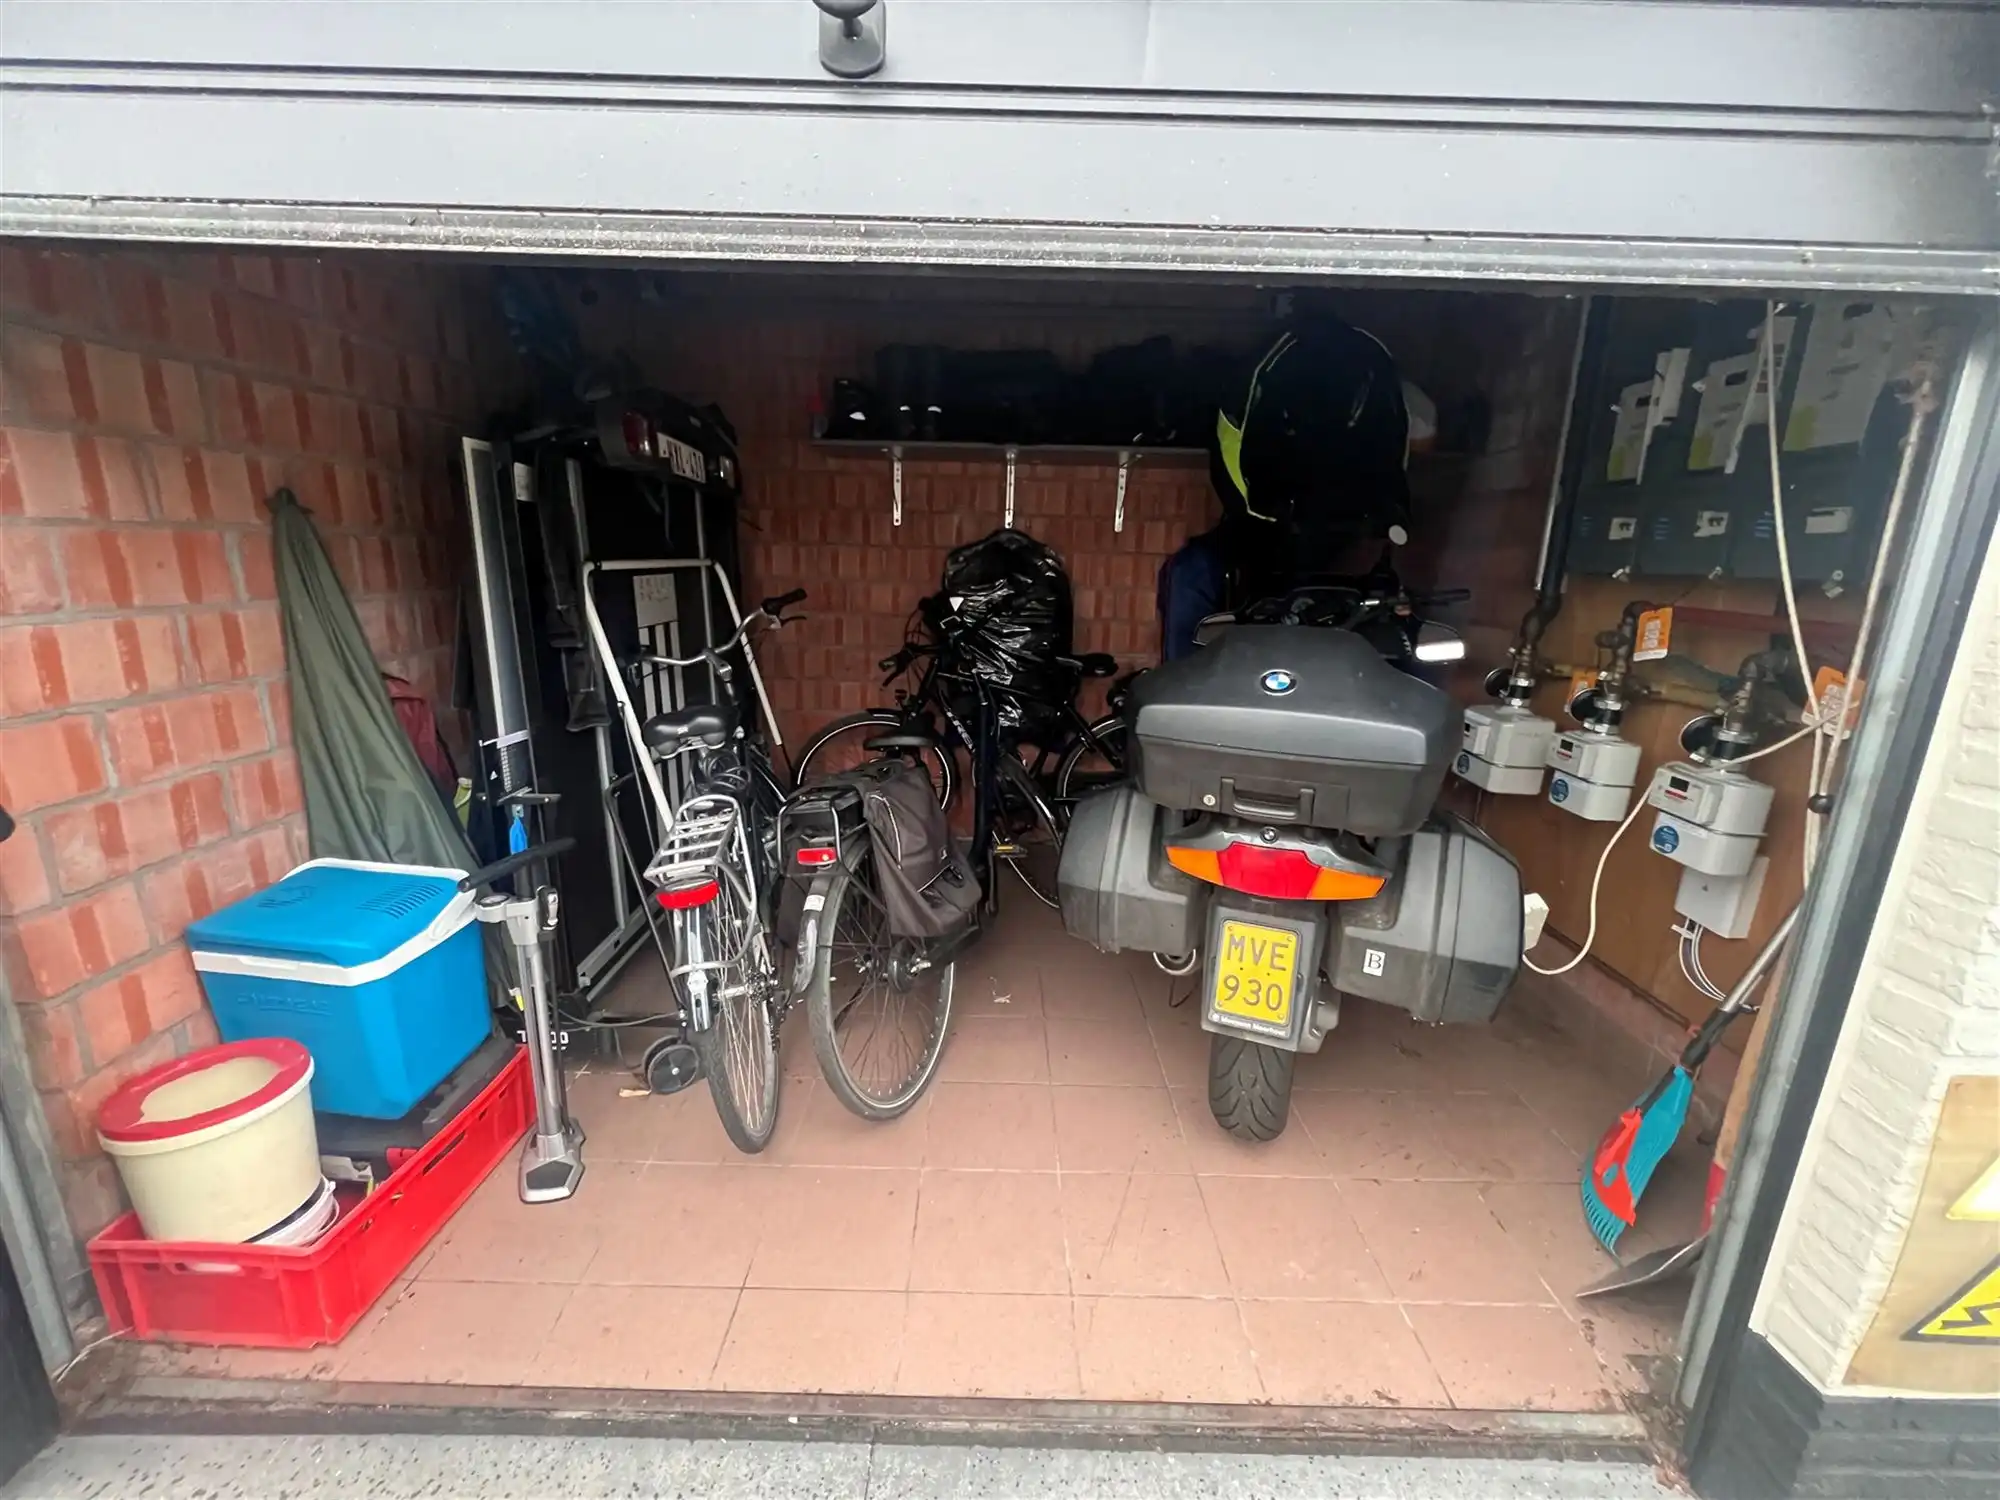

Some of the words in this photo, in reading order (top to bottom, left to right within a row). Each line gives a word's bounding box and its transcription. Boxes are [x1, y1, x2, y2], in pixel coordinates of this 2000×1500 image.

[1226, 934, 1289, 971] MVE
[1368, 952, 1382, 969] B
[1223, 974, 1283, 1011] 930
